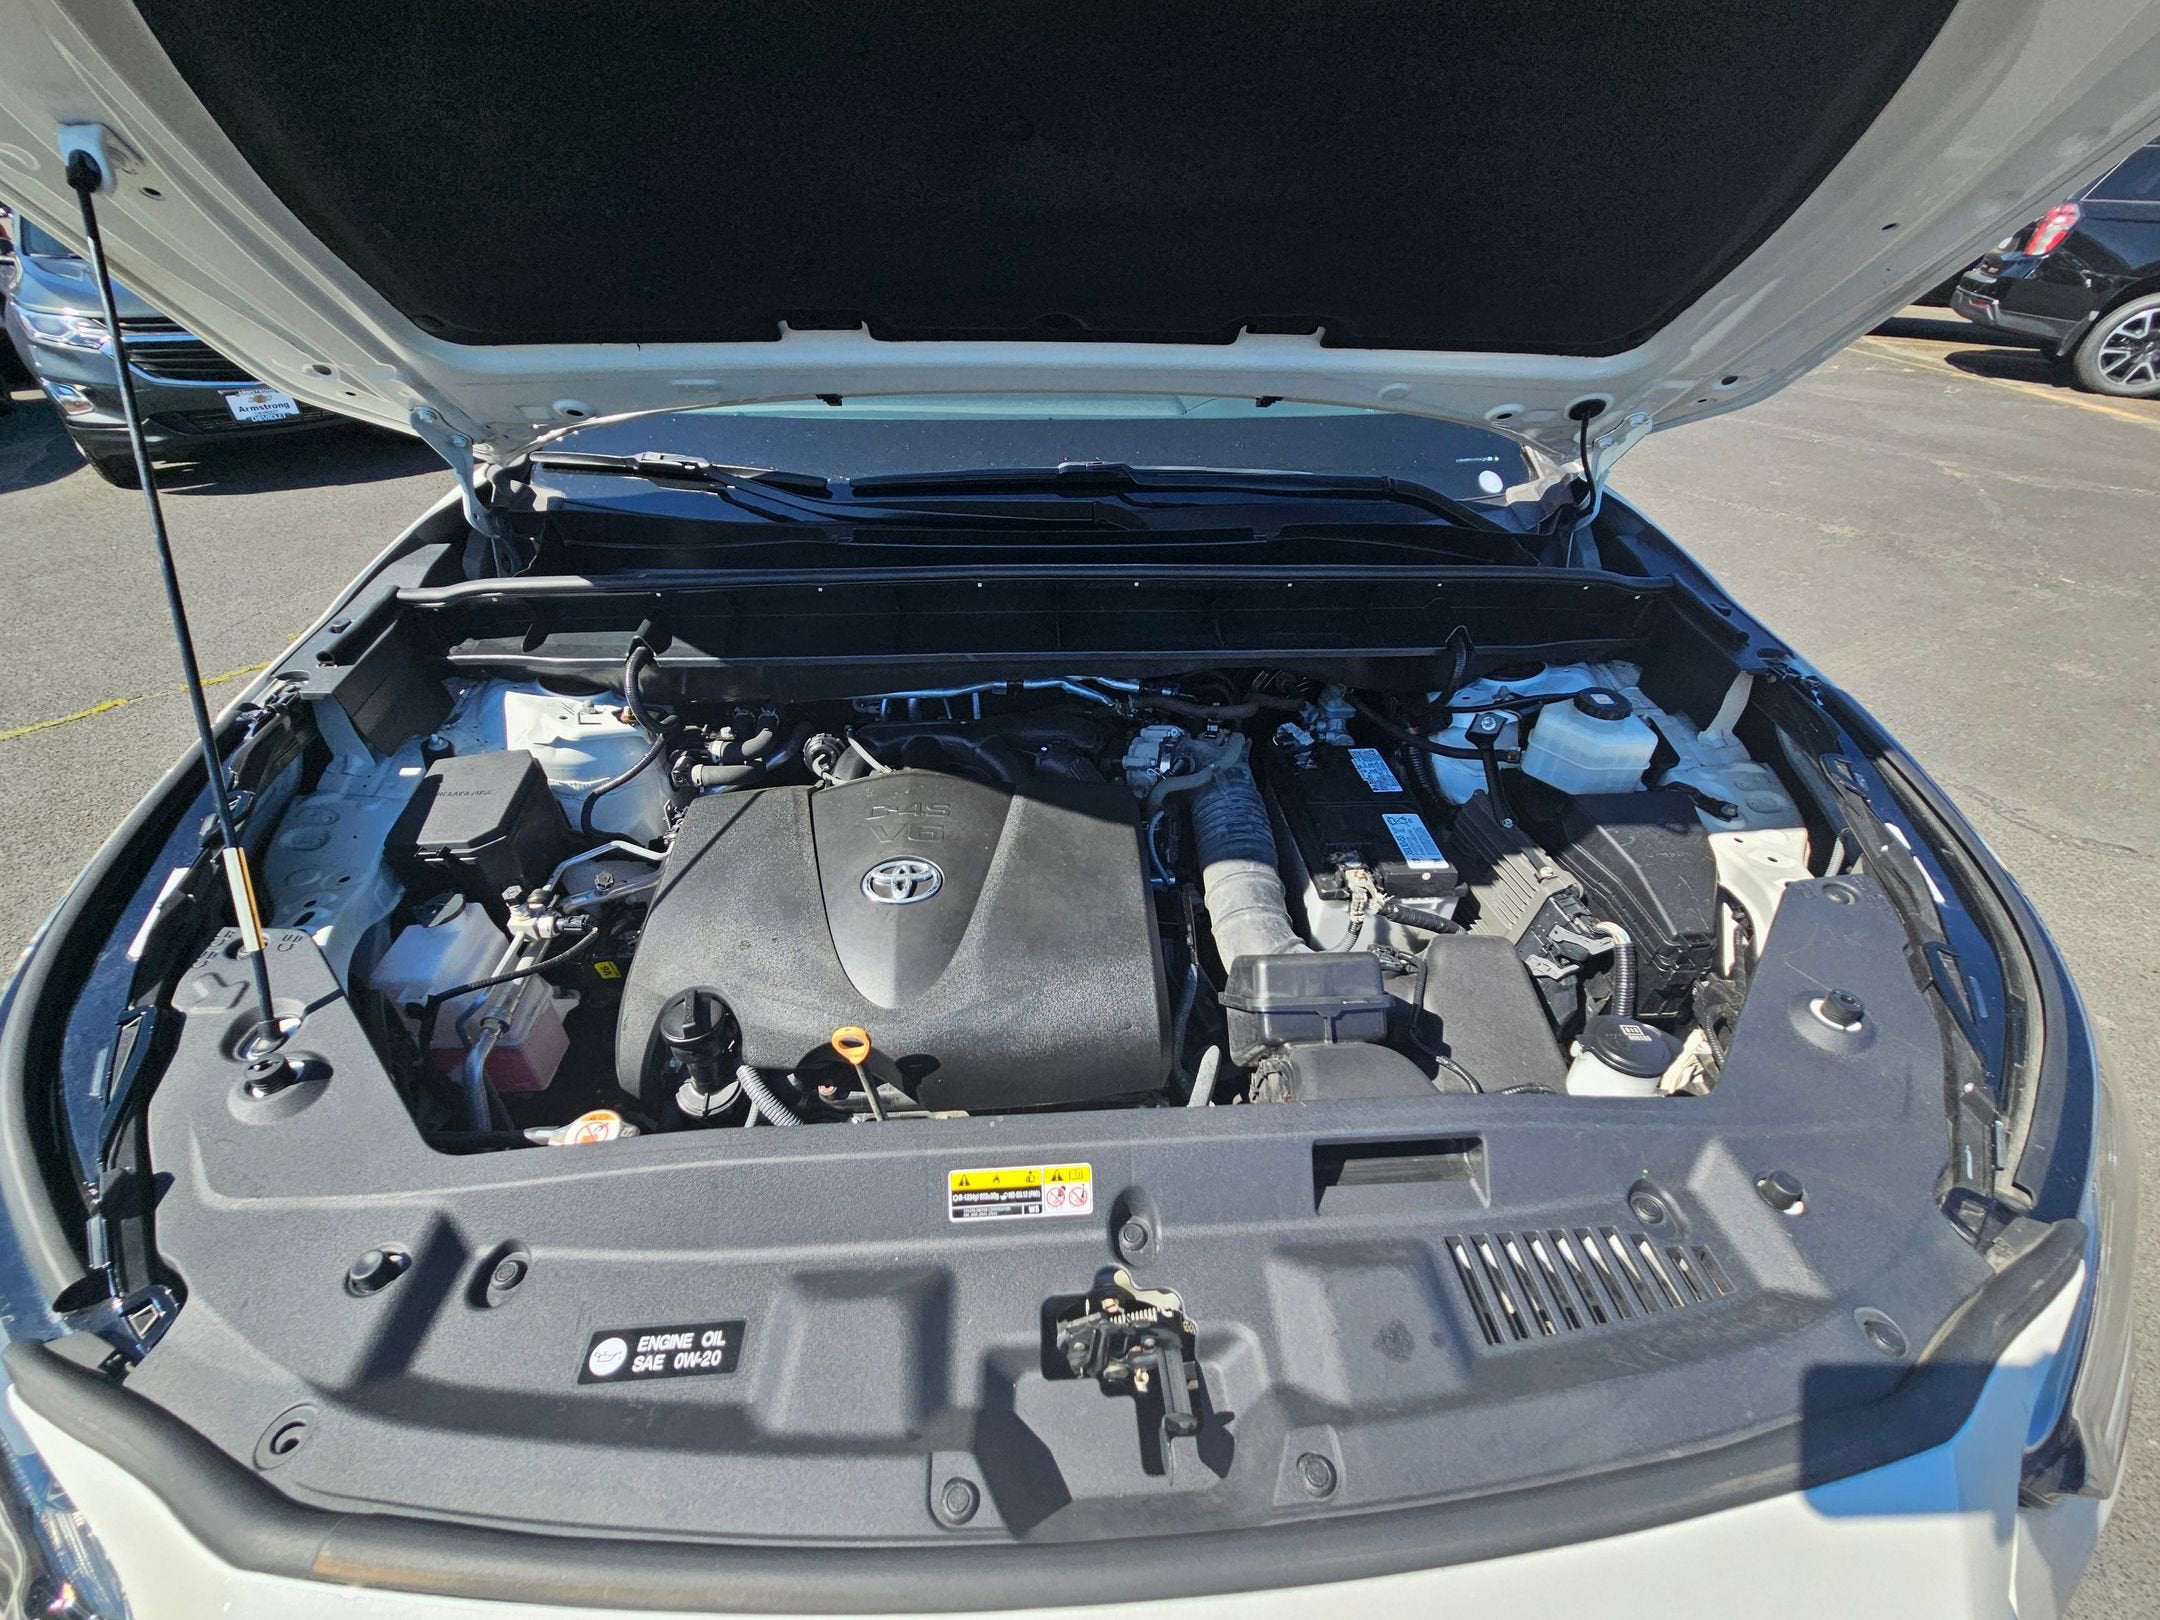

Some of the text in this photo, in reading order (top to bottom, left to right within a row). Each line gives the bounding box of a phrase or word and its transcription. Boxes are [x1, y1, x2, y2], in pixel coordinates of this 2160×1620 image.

[239, 402, 290, 412] Armstrong
[869, 823, 945, 844] V6
[637, 1330, 726, 1352] ENGINE OIL
[632, 1350, 722, 1372] SAE 0W-20
